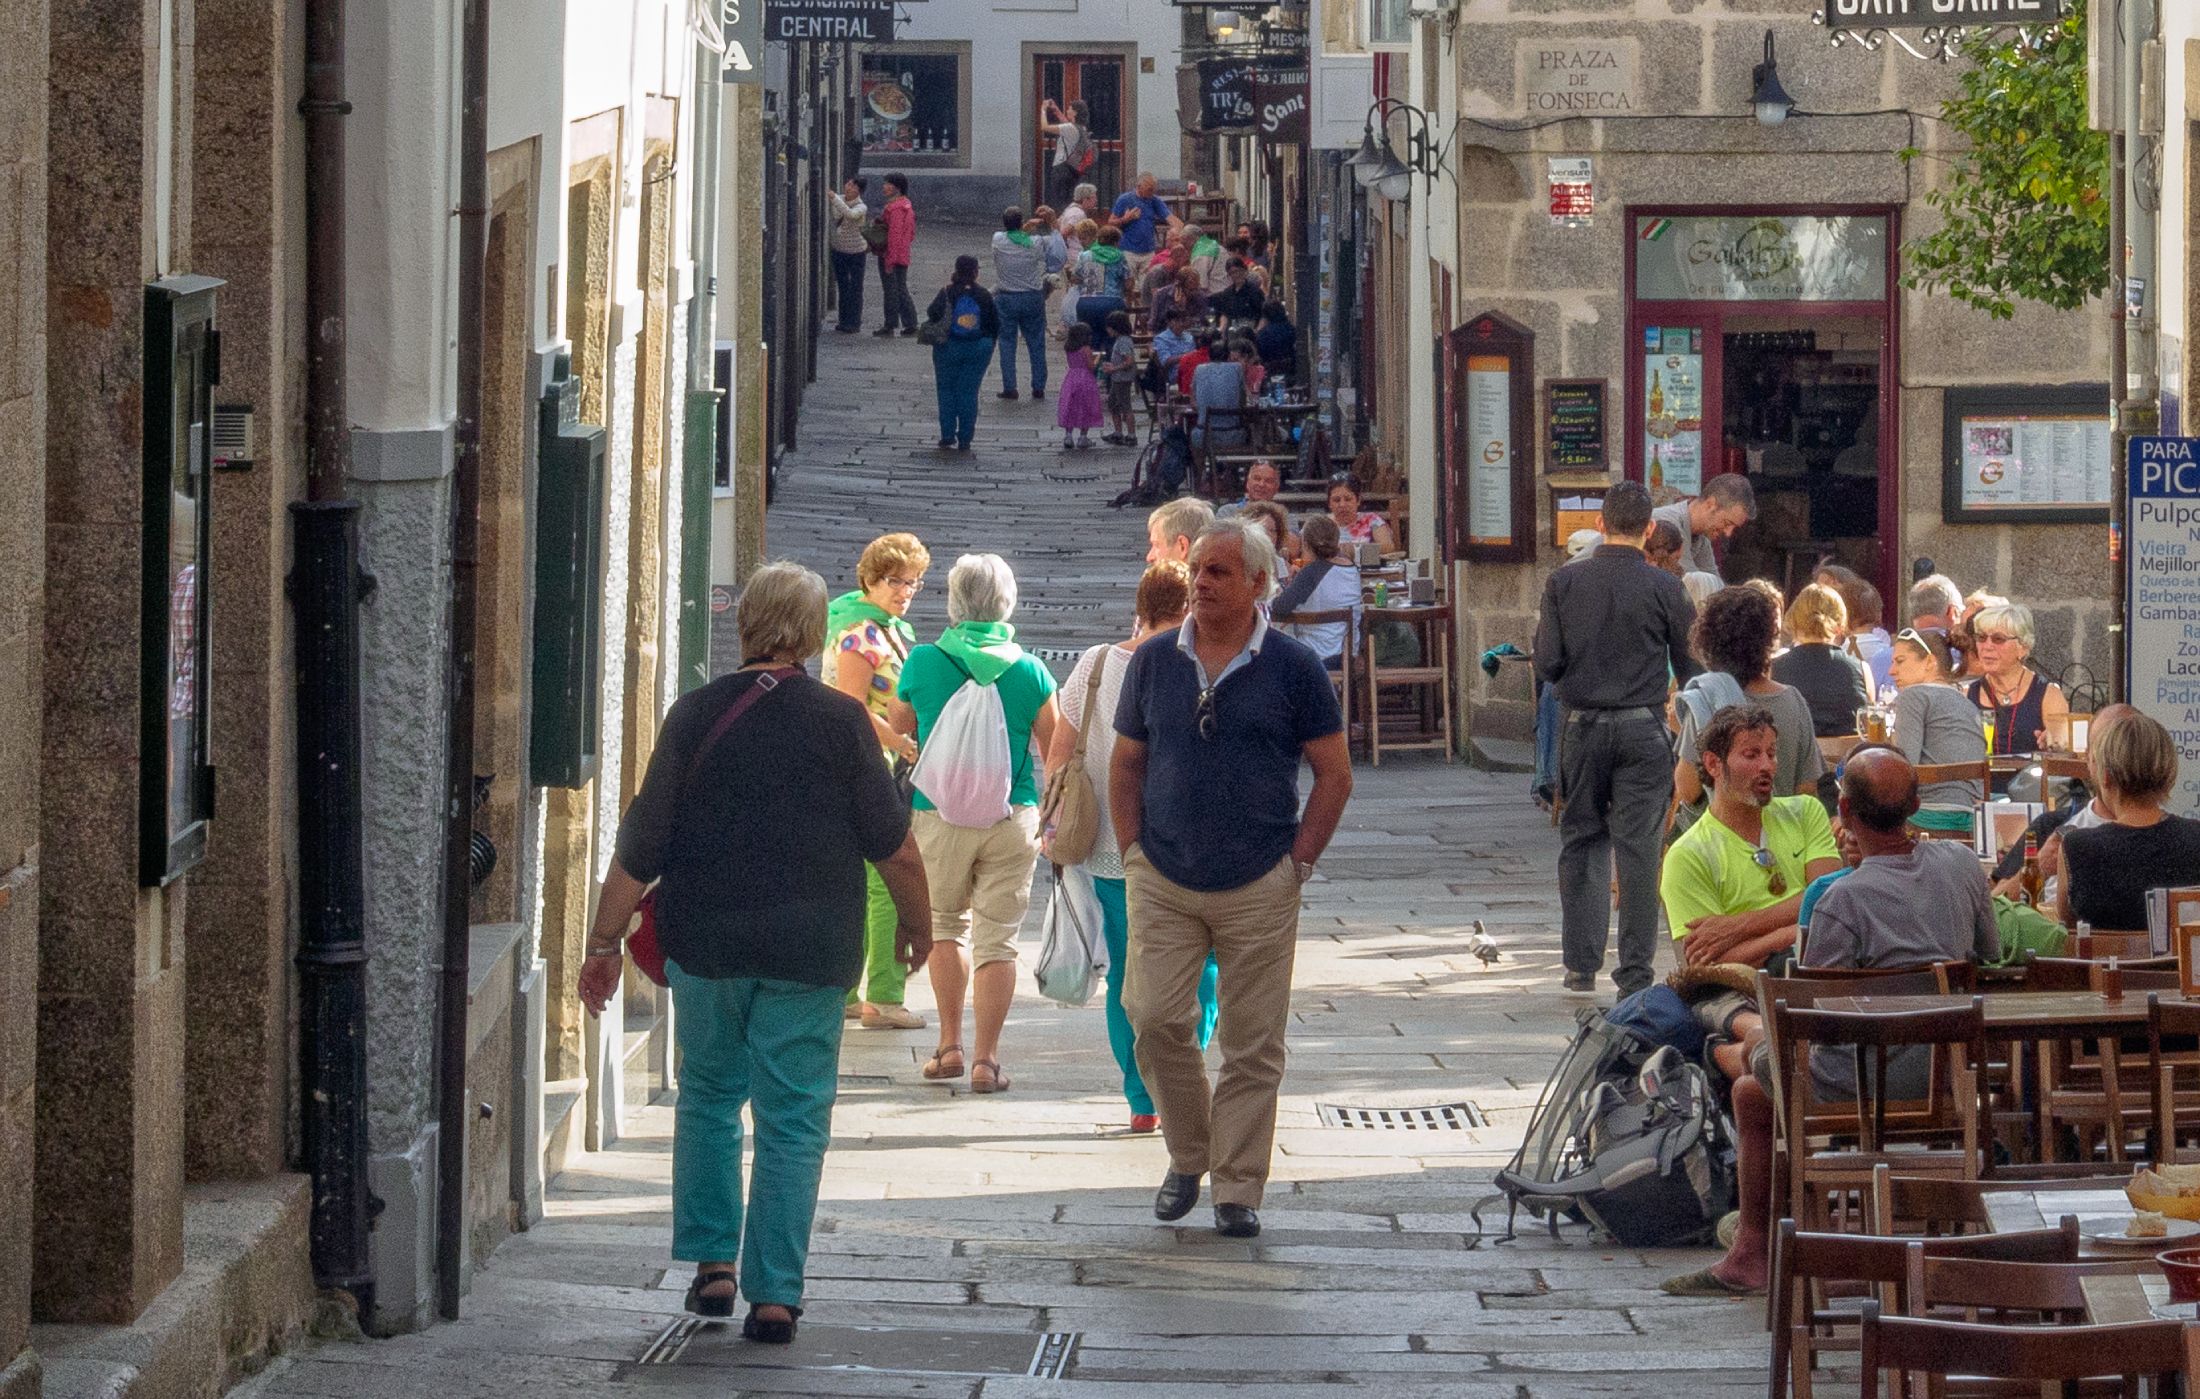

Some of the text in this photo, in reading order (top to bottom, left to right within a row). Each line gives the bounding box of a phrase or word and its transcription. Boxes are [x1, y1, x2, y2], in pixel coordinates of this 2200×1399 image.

[781, 16, 876, 38] CENTRAL
[1539, 50, 1618, 69] PRAZA
[1569, 74, 1589, 86] DE
[1527, 91, 1631, 110] FONSECA
[2142, 442, 2192, 459] PARA
[2142, 462, 2200, 493] PIC
[2139, 540, 2187, 555] Vieira
[2140, 574, 2179, 587] Queso
[2178, 641, 2200, 656] Zo
